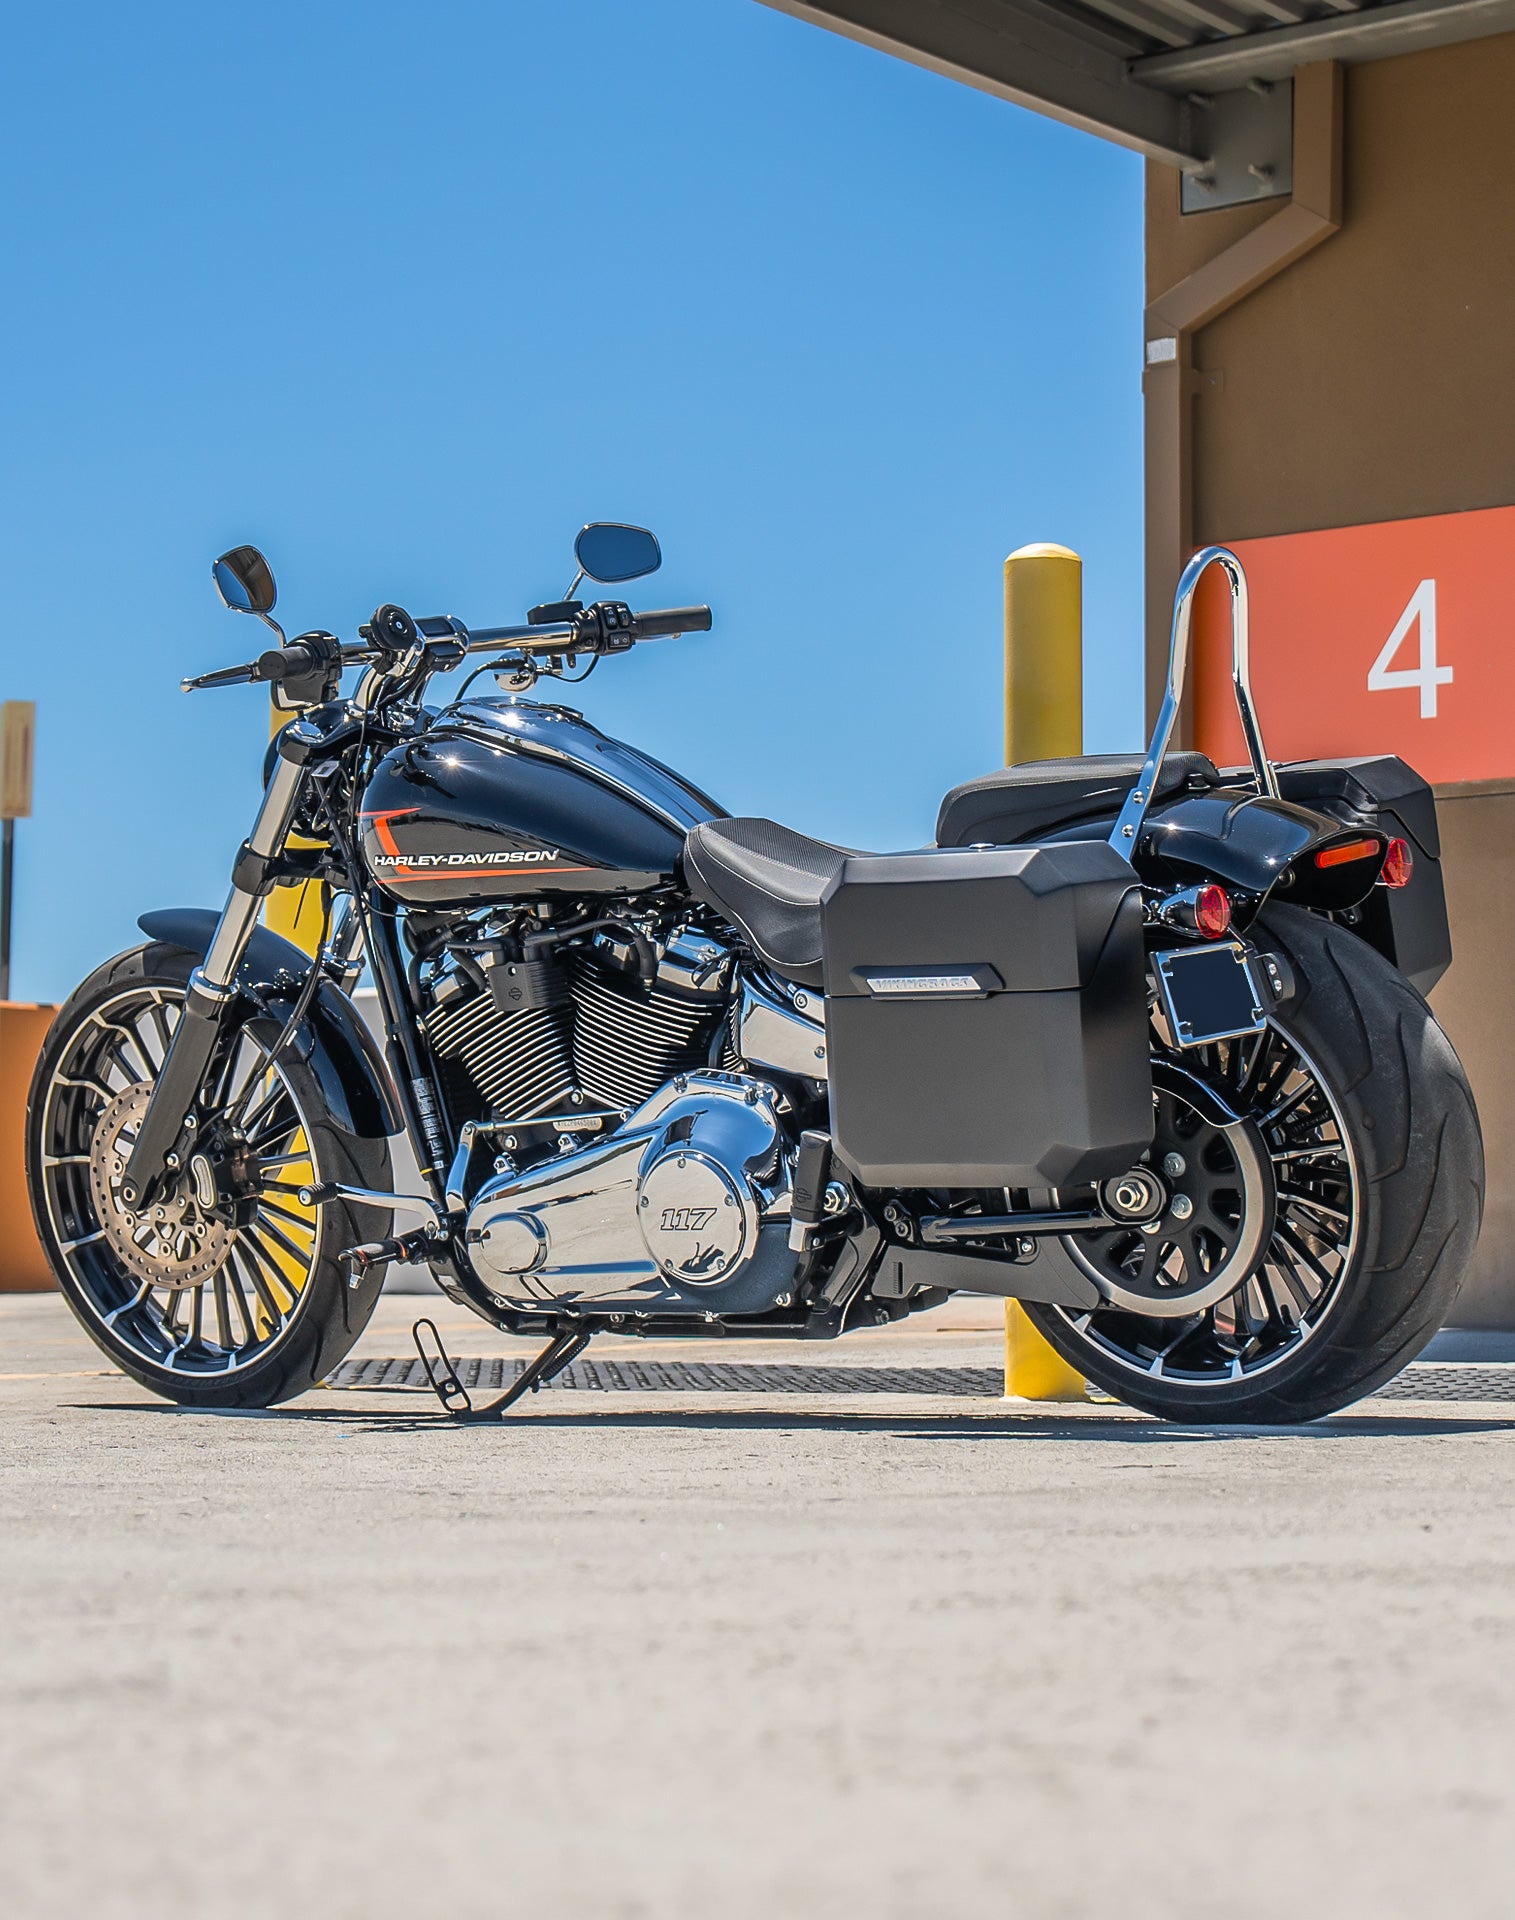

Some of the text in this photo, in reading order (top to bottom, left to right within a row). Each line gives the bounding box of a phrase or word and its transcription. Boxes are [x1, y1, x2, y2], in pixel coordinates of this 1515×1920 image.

[1367, 578, 1454, 719] 4
[374, 850, 558, 866] HARLEY-DAVIDSON
[660, 1207, 718, 1231] 117
